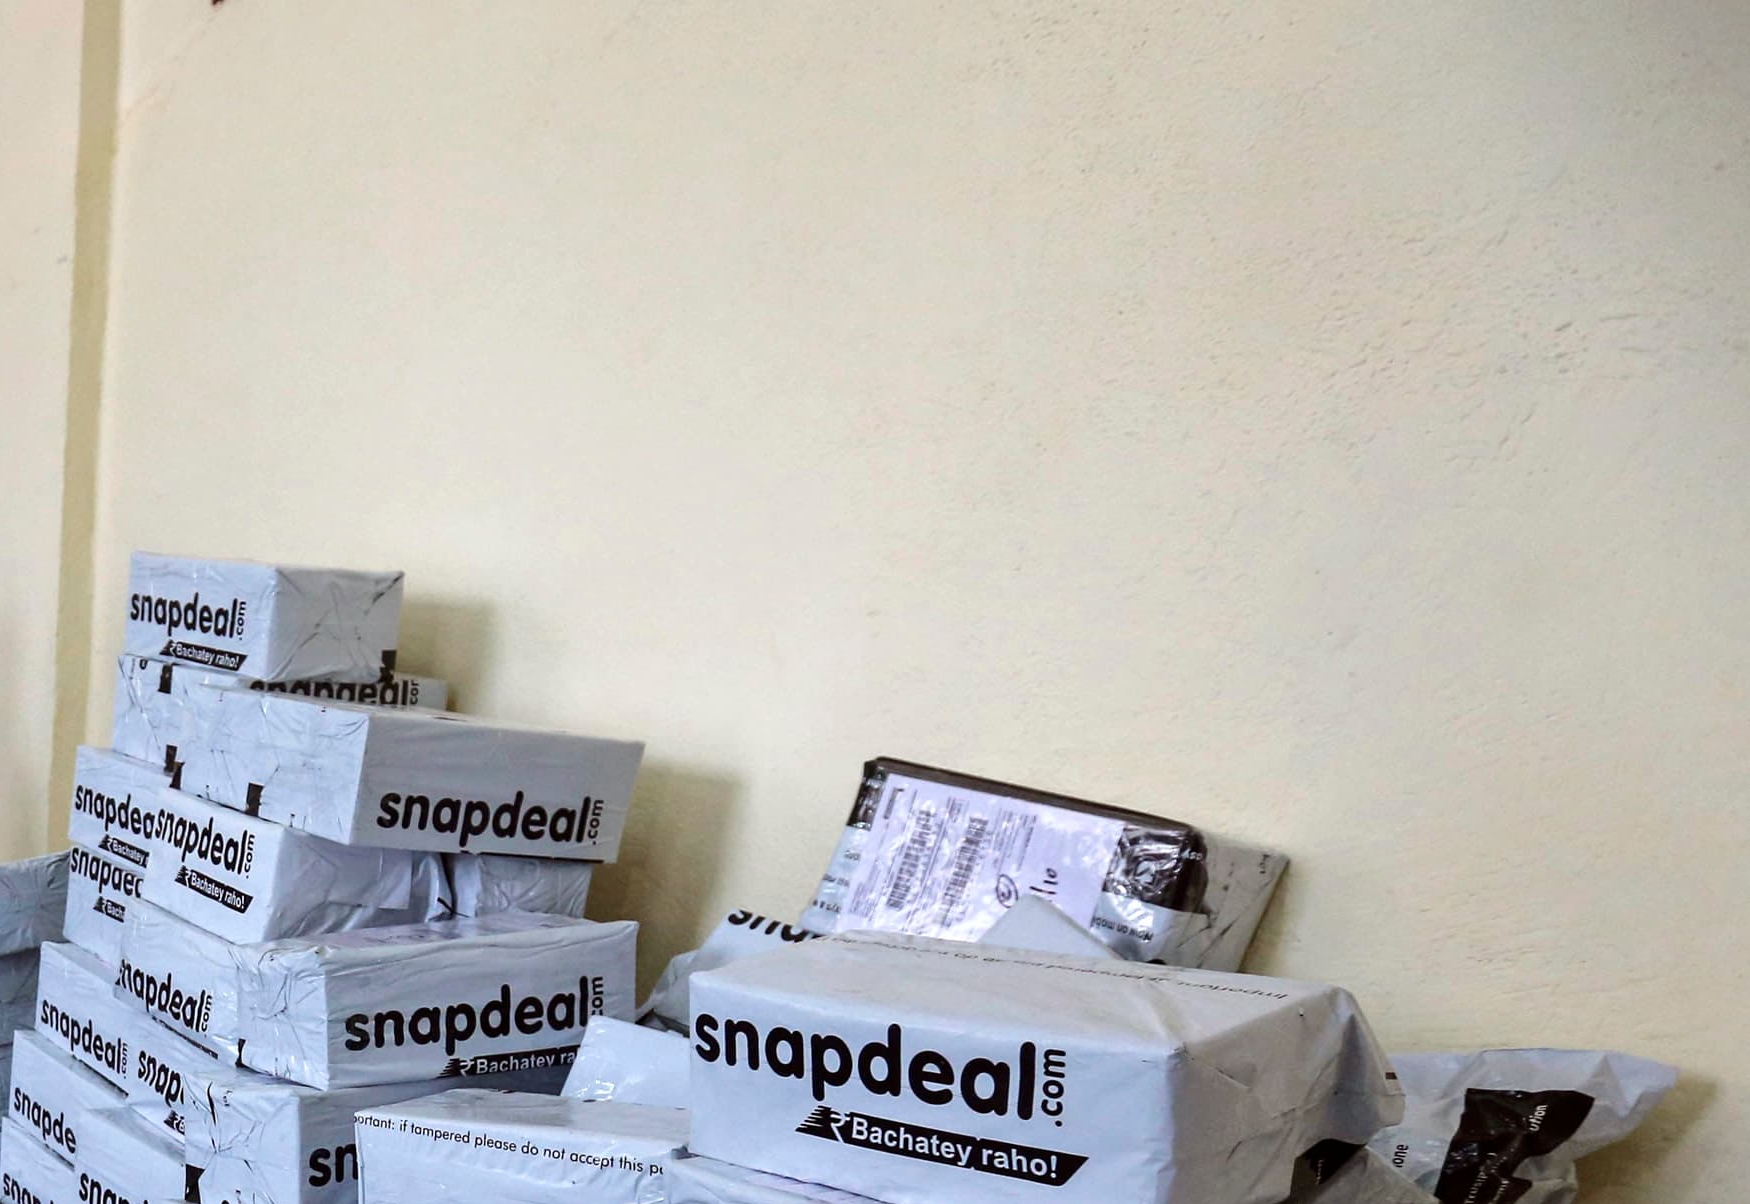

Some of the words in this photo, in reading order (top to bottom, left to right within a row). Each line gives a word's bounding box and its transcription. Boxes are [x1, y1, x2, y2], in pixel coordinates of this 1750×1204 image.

[130, 592, 237, 639] snapdeal
[155, 808, 248, 875] snapdeal
[376, 790, 590, 843] snapdeal
[190, 872, 224, 902] Bachatey
[224, 890, 245, 910] raho!
[41, 999, 123, 1076] snapdeal
[345, 975, 589, 1056] snapdeal
[695, 1012, 1036, 1121] snapdeal
[399, 1119, 408, 1133] if
[410, 1122, 471, 1145] tampered
[474, 1133, 517, 1153] please
[521, 1141, 539, 1156] do
[543, 1145, 566, 1160] not
[569, 1150, 615, 1170] accept
[618, 1156, 643, 1173] this
[852, 1117, 973, 1168] Bachatey
[980, 1144, 1059, 1181] raho!
